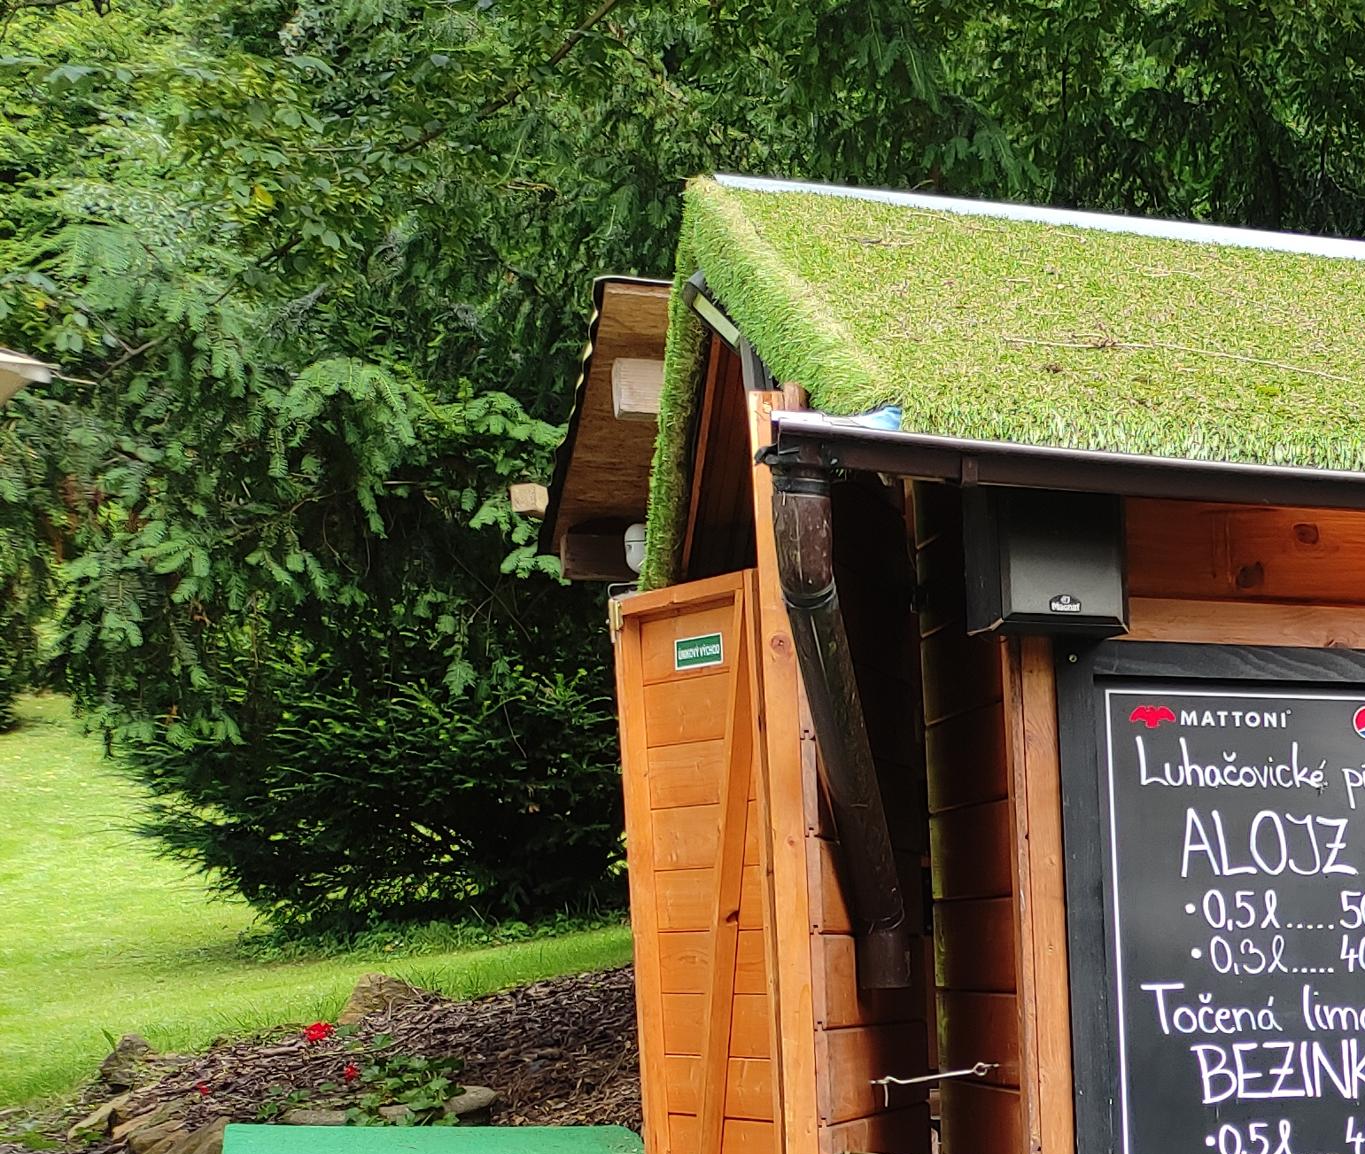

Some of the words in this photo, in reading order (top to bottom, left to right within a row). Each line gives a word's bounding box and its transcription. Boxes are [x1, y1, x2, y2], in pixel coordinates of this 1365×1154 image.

[1181, 709, 1287, 728] MATTONI
[1136, 736, 1327, 788] Luhačovické
[1182, 808, 1358, 877] ALOJZ
[1141, 983, 1283, 1034] Točená
